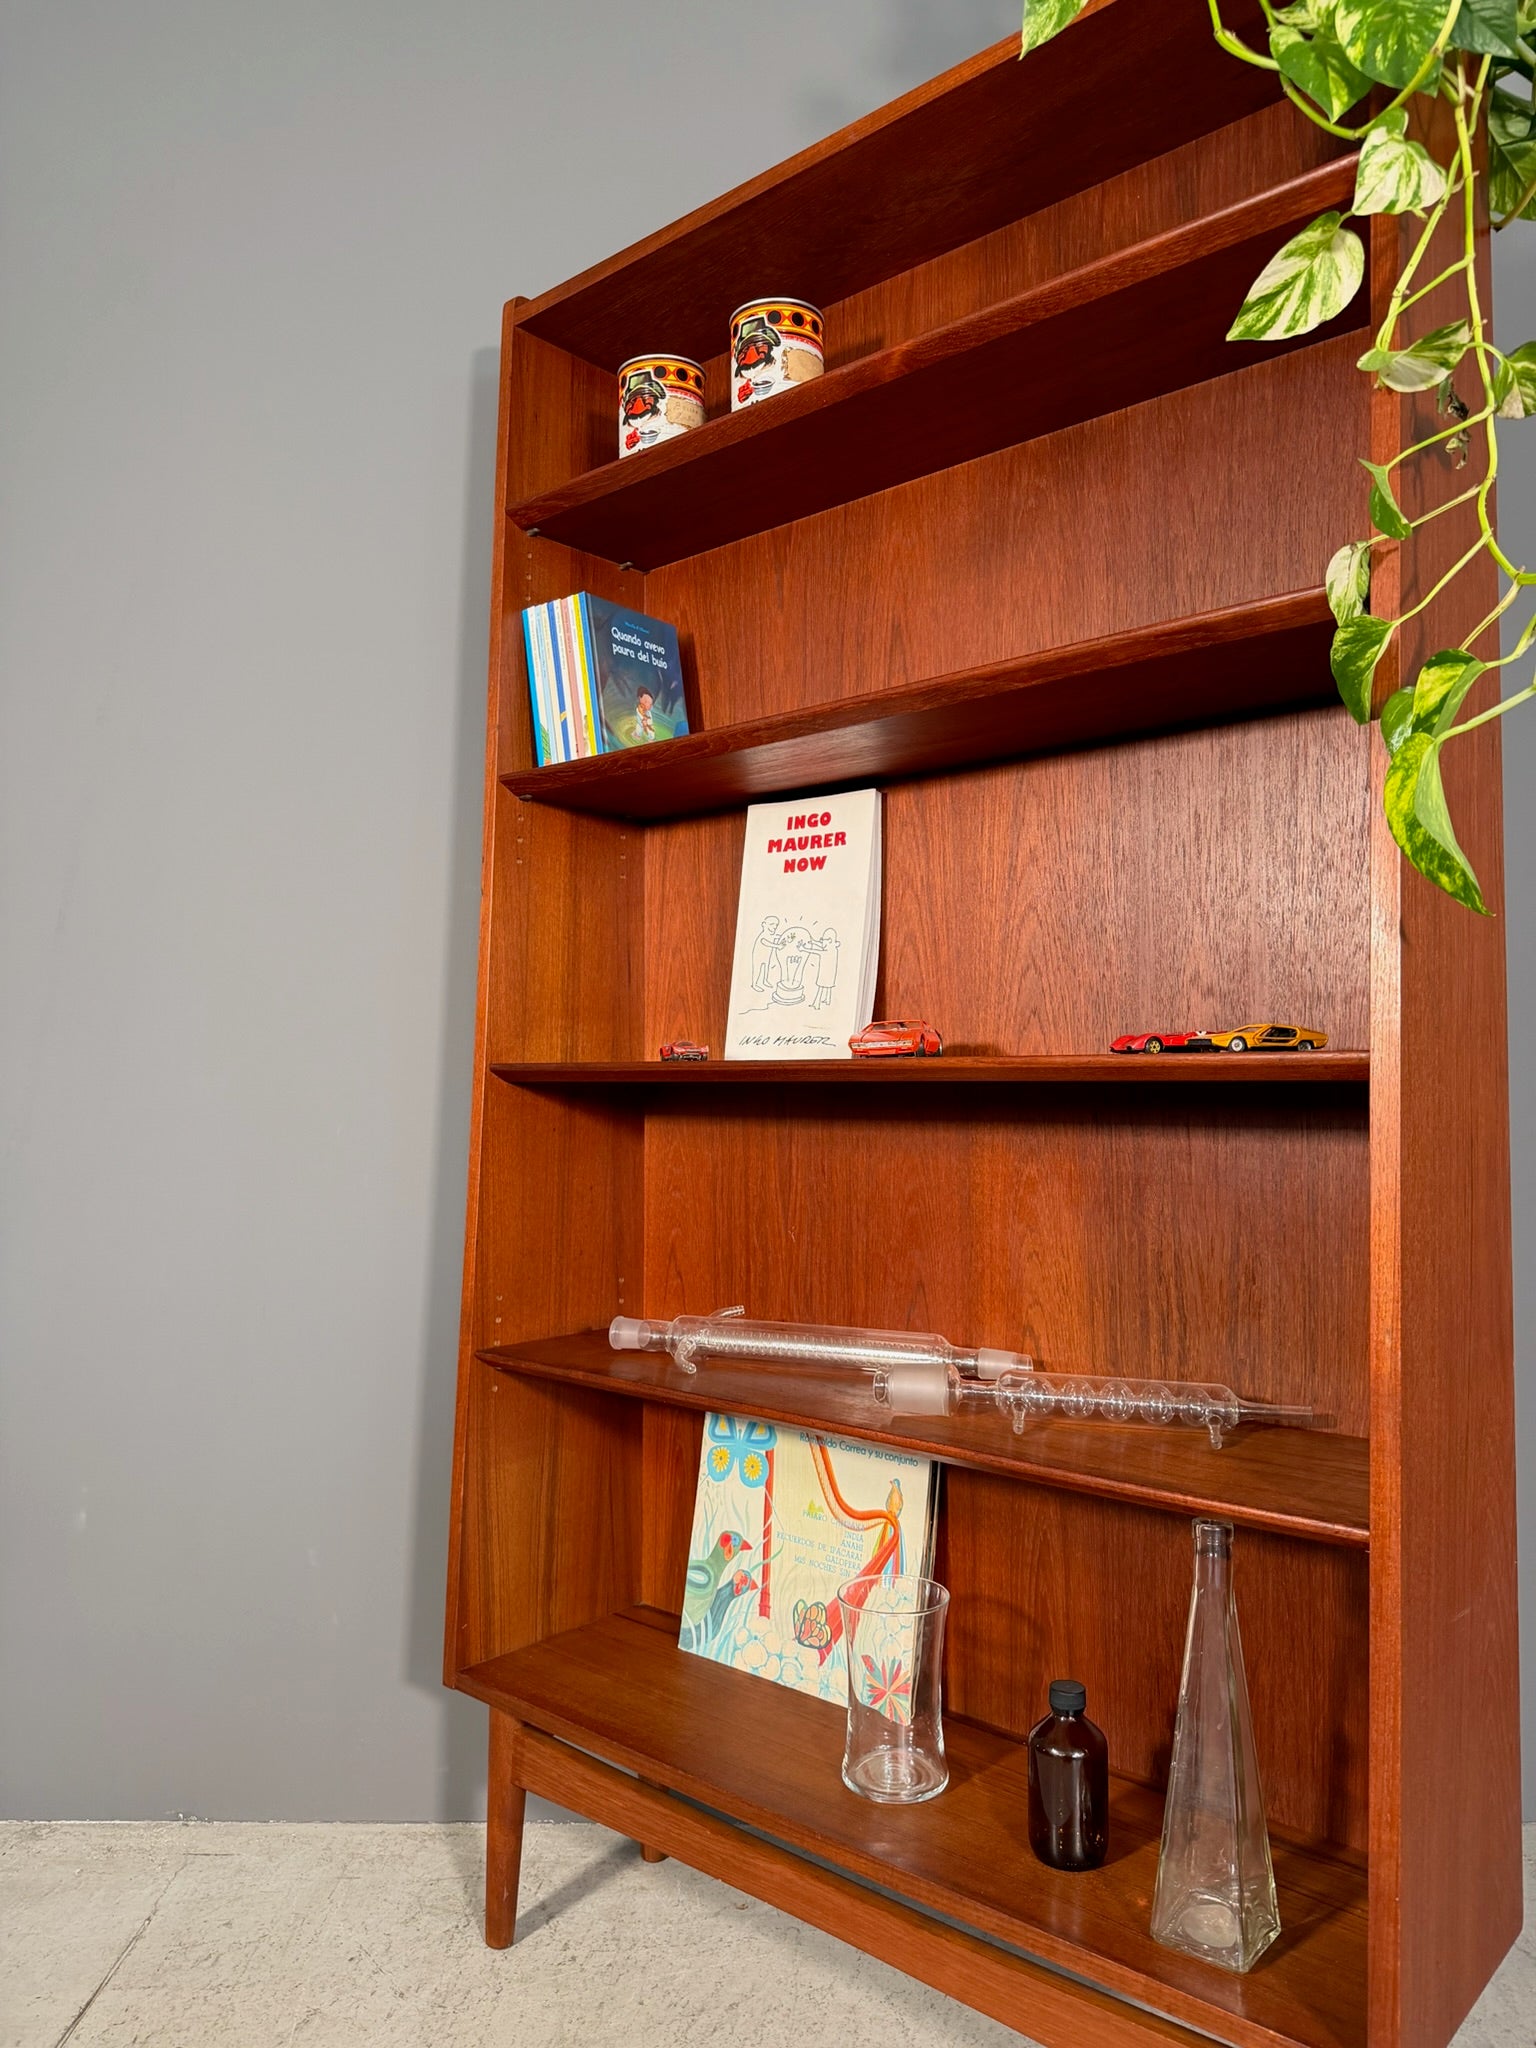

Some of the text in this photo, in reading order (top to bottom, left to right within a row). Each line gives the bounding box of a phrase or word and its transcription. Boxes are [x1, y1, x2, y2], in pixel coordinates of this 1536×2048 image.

[611, 627, 641, 646] Quando
[644, 641, 665, 654] aveva
[612, 643, 667, 669] paura del buio
[787, 812, 831, 830] INGO
[767, 831, 846, 853] MAURER
[784, 855, 827, 873] NOW
[839, 1440, 866, 1455] Correa
[867, 1449, 874, 1459] y
[875, 1450, 884, 1460] su
[885, 1452, 919, 1468] conjunto
[818, 1542, 827, 1552] DE
